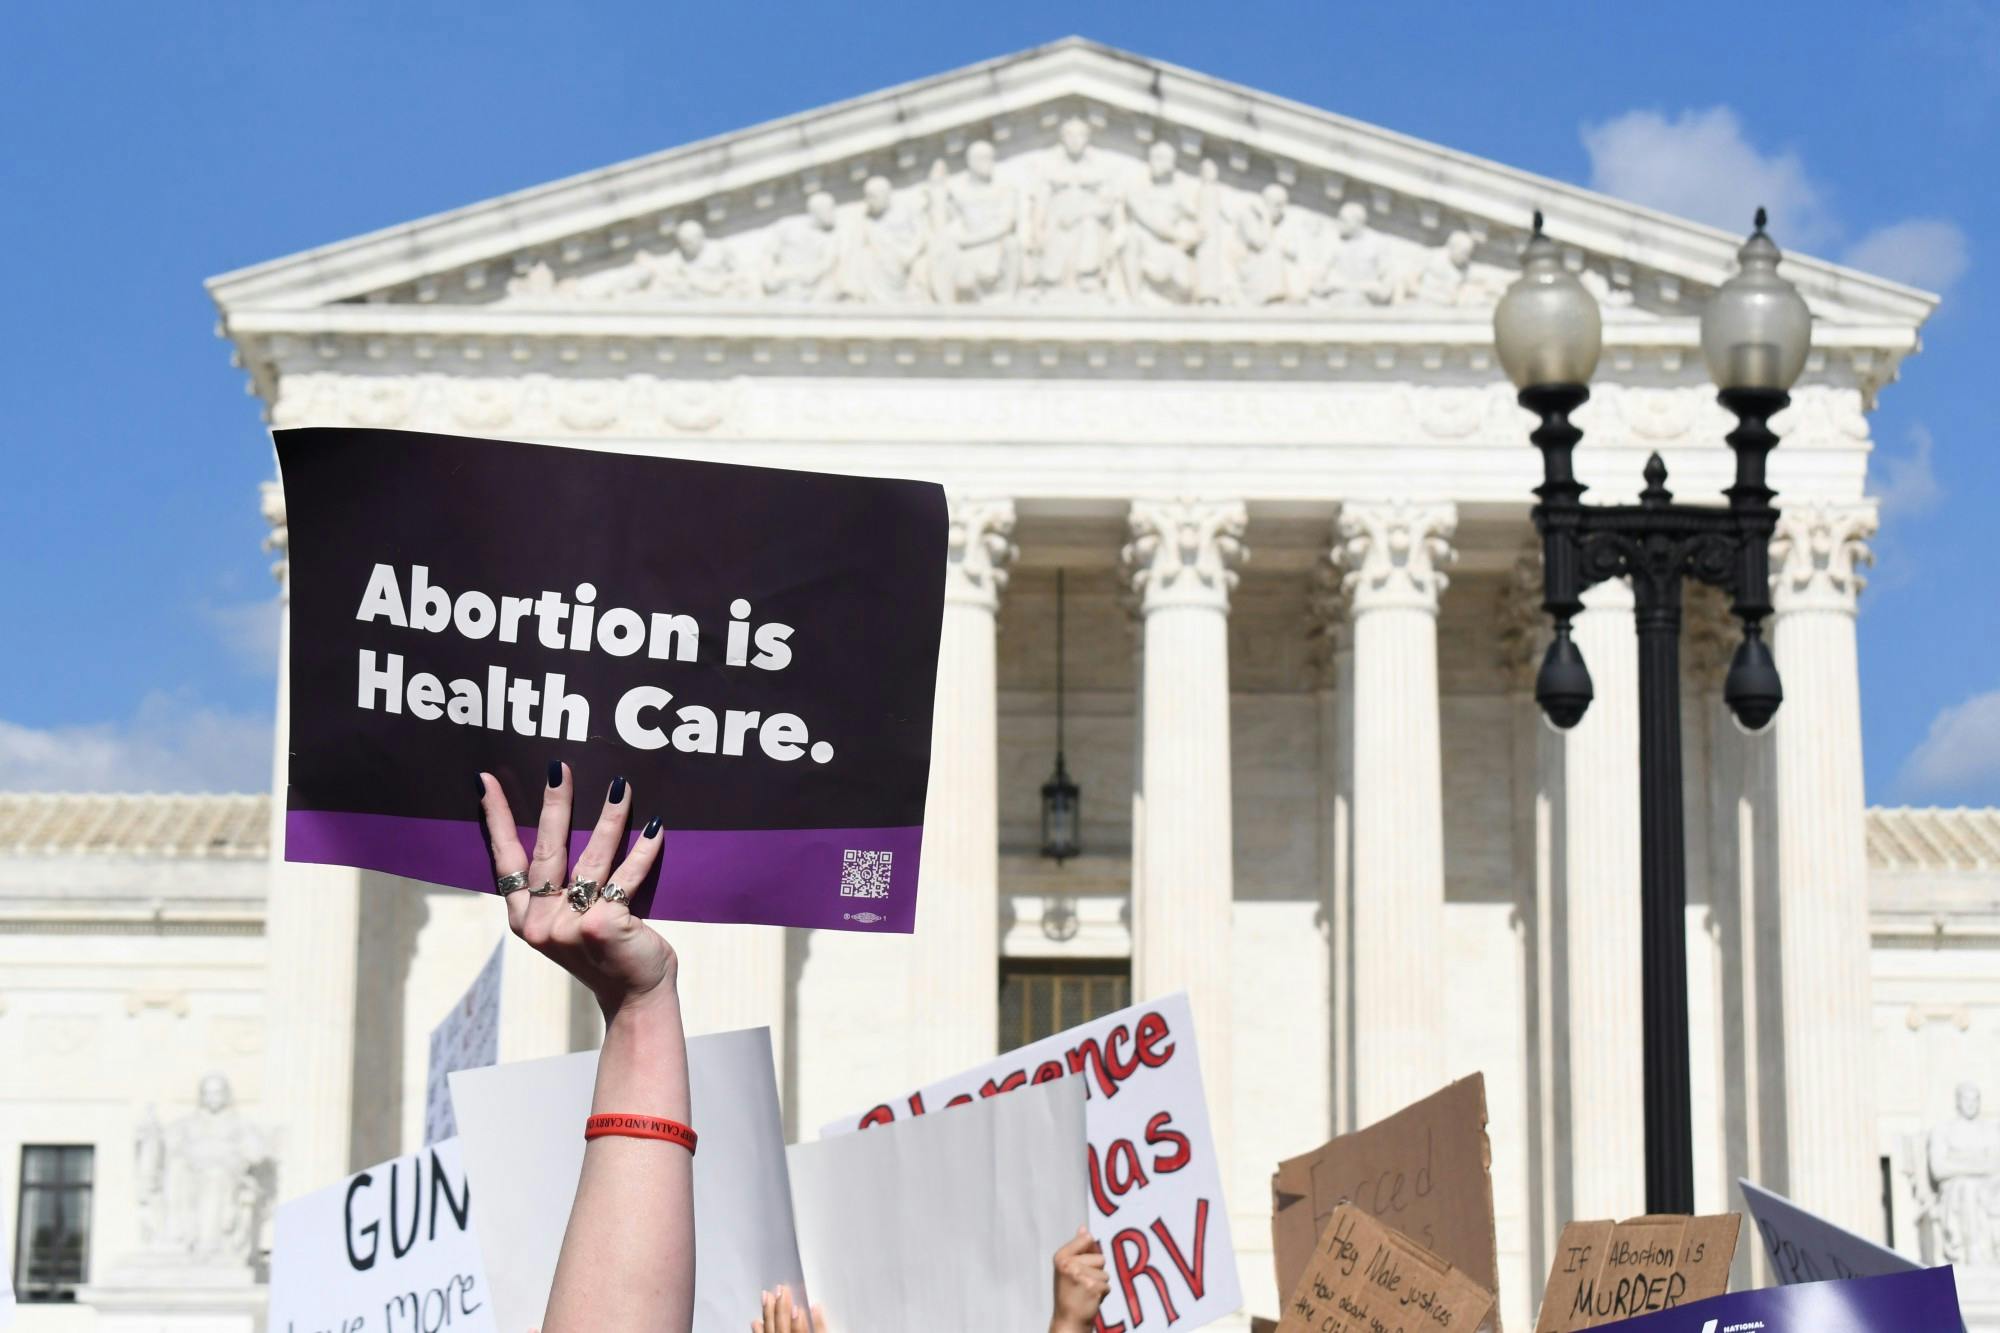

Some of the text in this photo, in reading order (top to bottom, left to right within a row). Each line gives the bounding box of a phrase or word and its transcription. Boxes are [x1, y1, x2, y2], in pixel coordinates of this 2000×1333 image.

[356, 564, 795, 671] Abortion is
[357, 648, 834, 764] Health Care.
[596, 1117, 623, 1128] CARRY
[625, 1118, 650, 1129] AND
[651, 1120, 680, 1136] CALM
[344, 1148, 471, 1272] GUN
[1327, 1213, 1359, 1277] Hey
[1364, 1243, 1401, 1292] Male
[385, 1274, 482, 1333] more
[1723, 1321, 1765, 1333] NATIONAL
